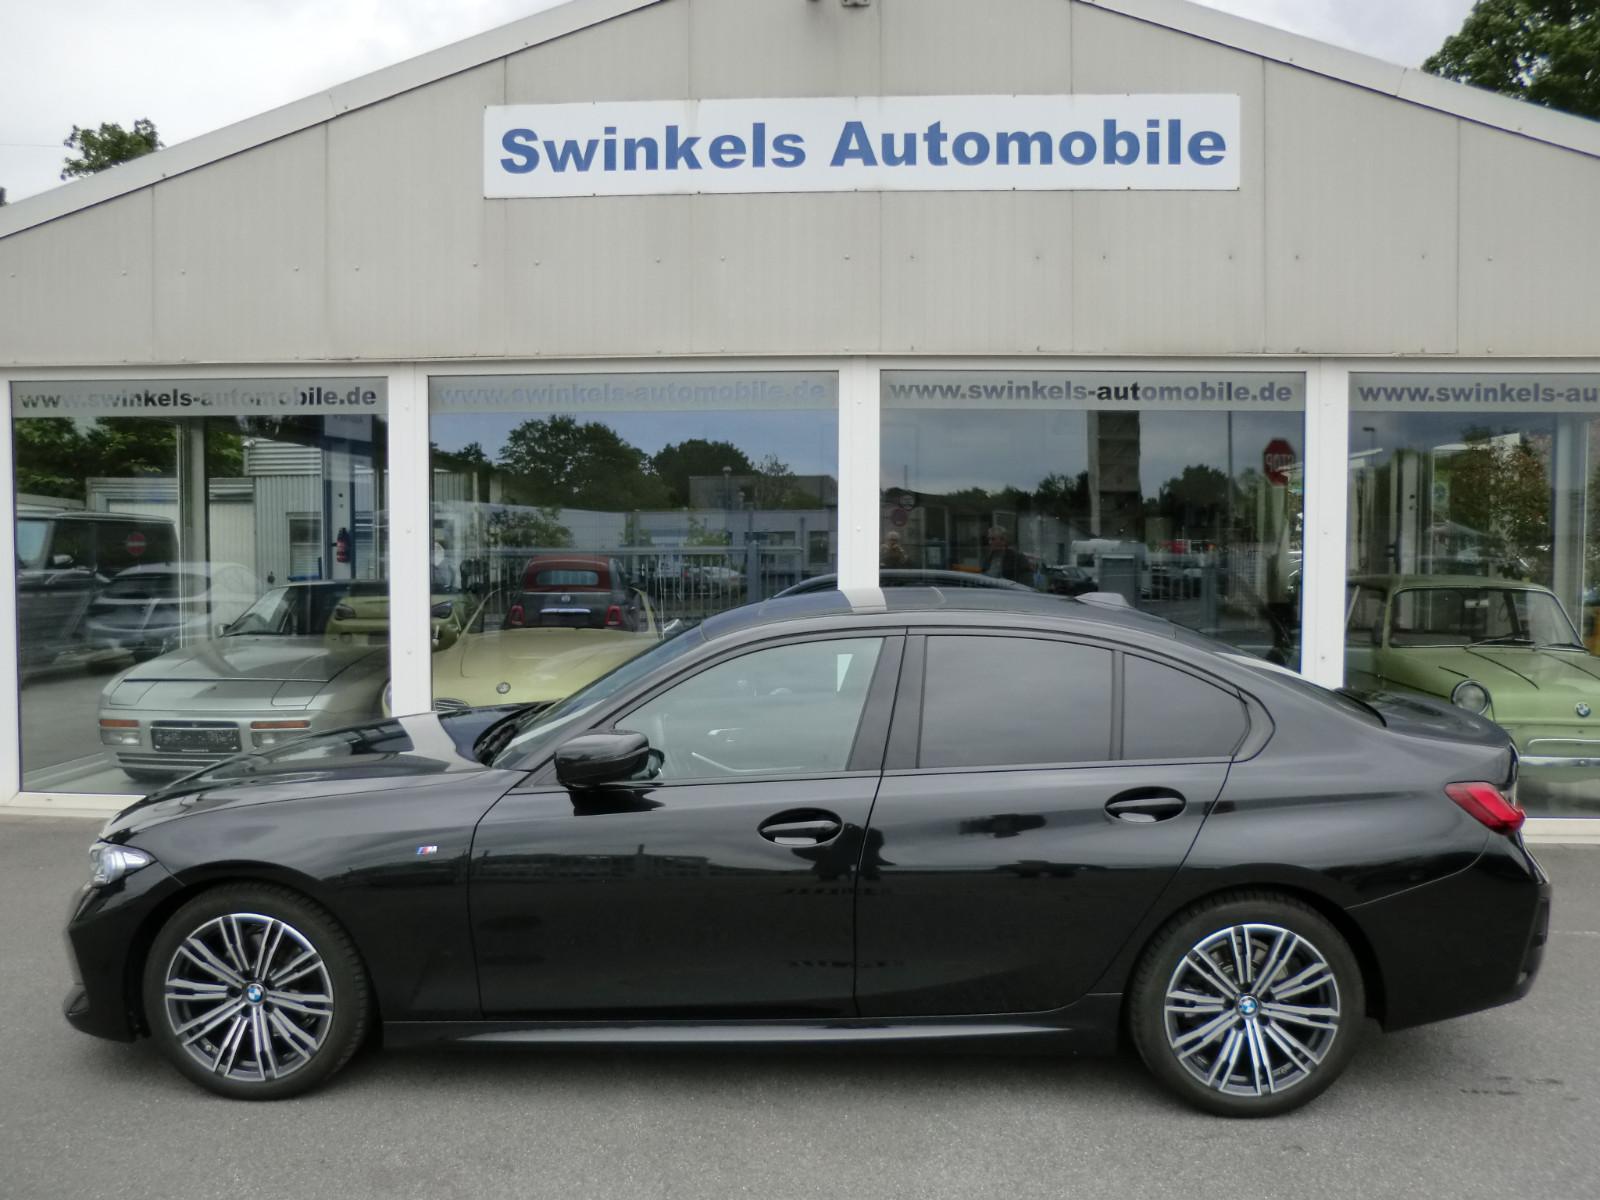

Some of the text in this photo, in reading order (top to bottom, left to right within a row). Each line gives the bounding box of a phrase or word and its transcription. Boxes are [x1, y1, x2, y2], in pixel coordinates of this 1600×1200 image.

[500, 118, 1227, 175] Swinkels Automobile
[889, 380, 1293, 401] www.swinkels-automobile.de
[1358, 382, 1600, 403] www.swinkels-au
